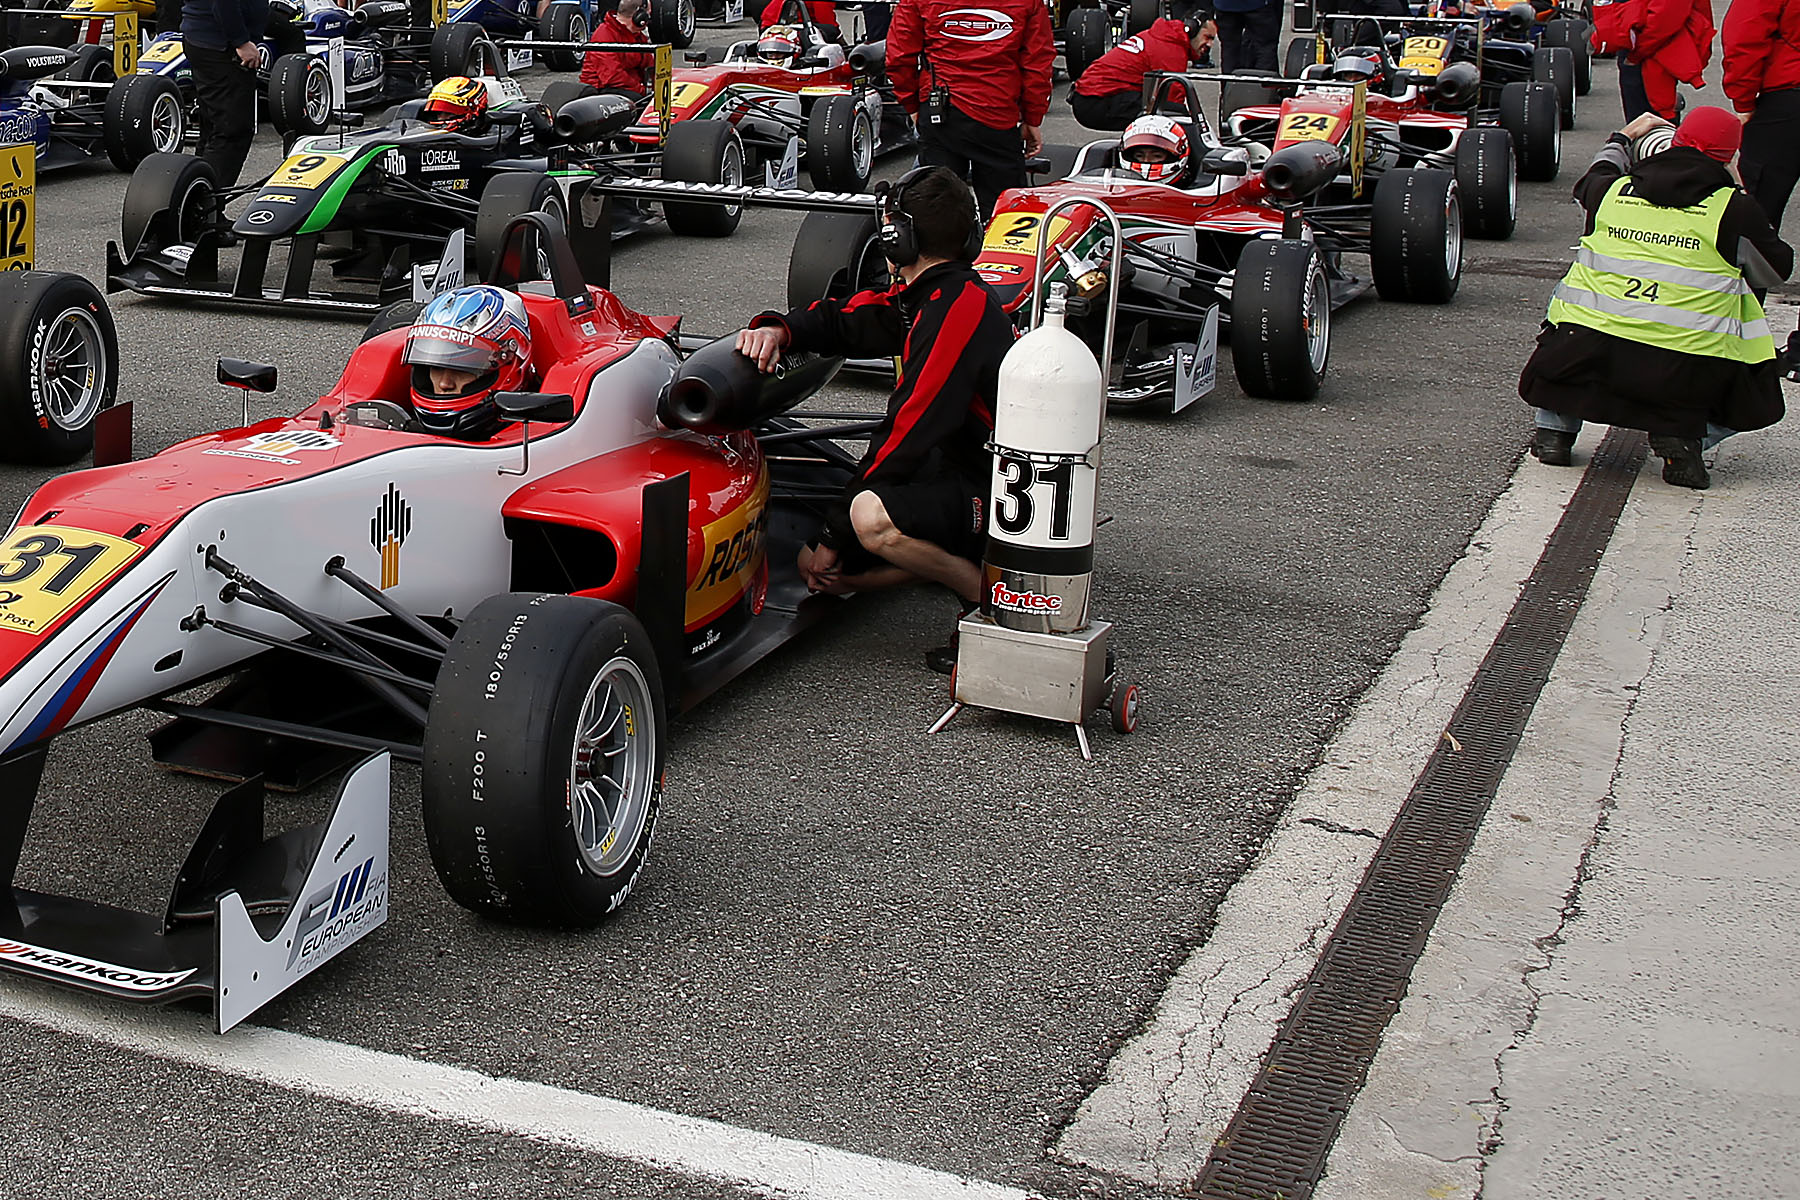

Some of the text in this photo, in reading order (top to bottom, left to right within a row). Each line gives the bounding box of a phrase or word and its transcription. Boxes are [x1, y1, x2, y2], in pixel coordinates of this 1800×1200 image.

[944, 19, 1014, 32] PREMA
[156, 44, 173, 54] 4
[1406, 37, 1441, 50] 20
[26, 54, 67, 68] VOLKSWAGEN
[121, 42, 132, 73] 8
[660, 79, 669, 118] 9
[1287, 115, 1330, 131] 24
[288, 156, 325, 174] 9
[16, 184, 34, 198] Post
[624, 177, 877, 205] MANUSCRIP
[1003, 215, 1039, 239] 2
[1607, 226, 1701, 251] PHOTOGRAPHER
[1623, 278, 1660, 303] 24
[994, 452, 1075, 541] 31
[990, 581, 1064, 609] fortec
[5, 612, 36, 629] Post
[999, 604, 1062, 616] motorsports
[484, 614, 528, 702] 180/550R13
[472, 728, 488, 802] F200 T
[366, 870, 387, 897] FIA
[301, 892, 385, 958] EUROPEAN
[296, 911, 383, 975] CHAMPIONSHIP
